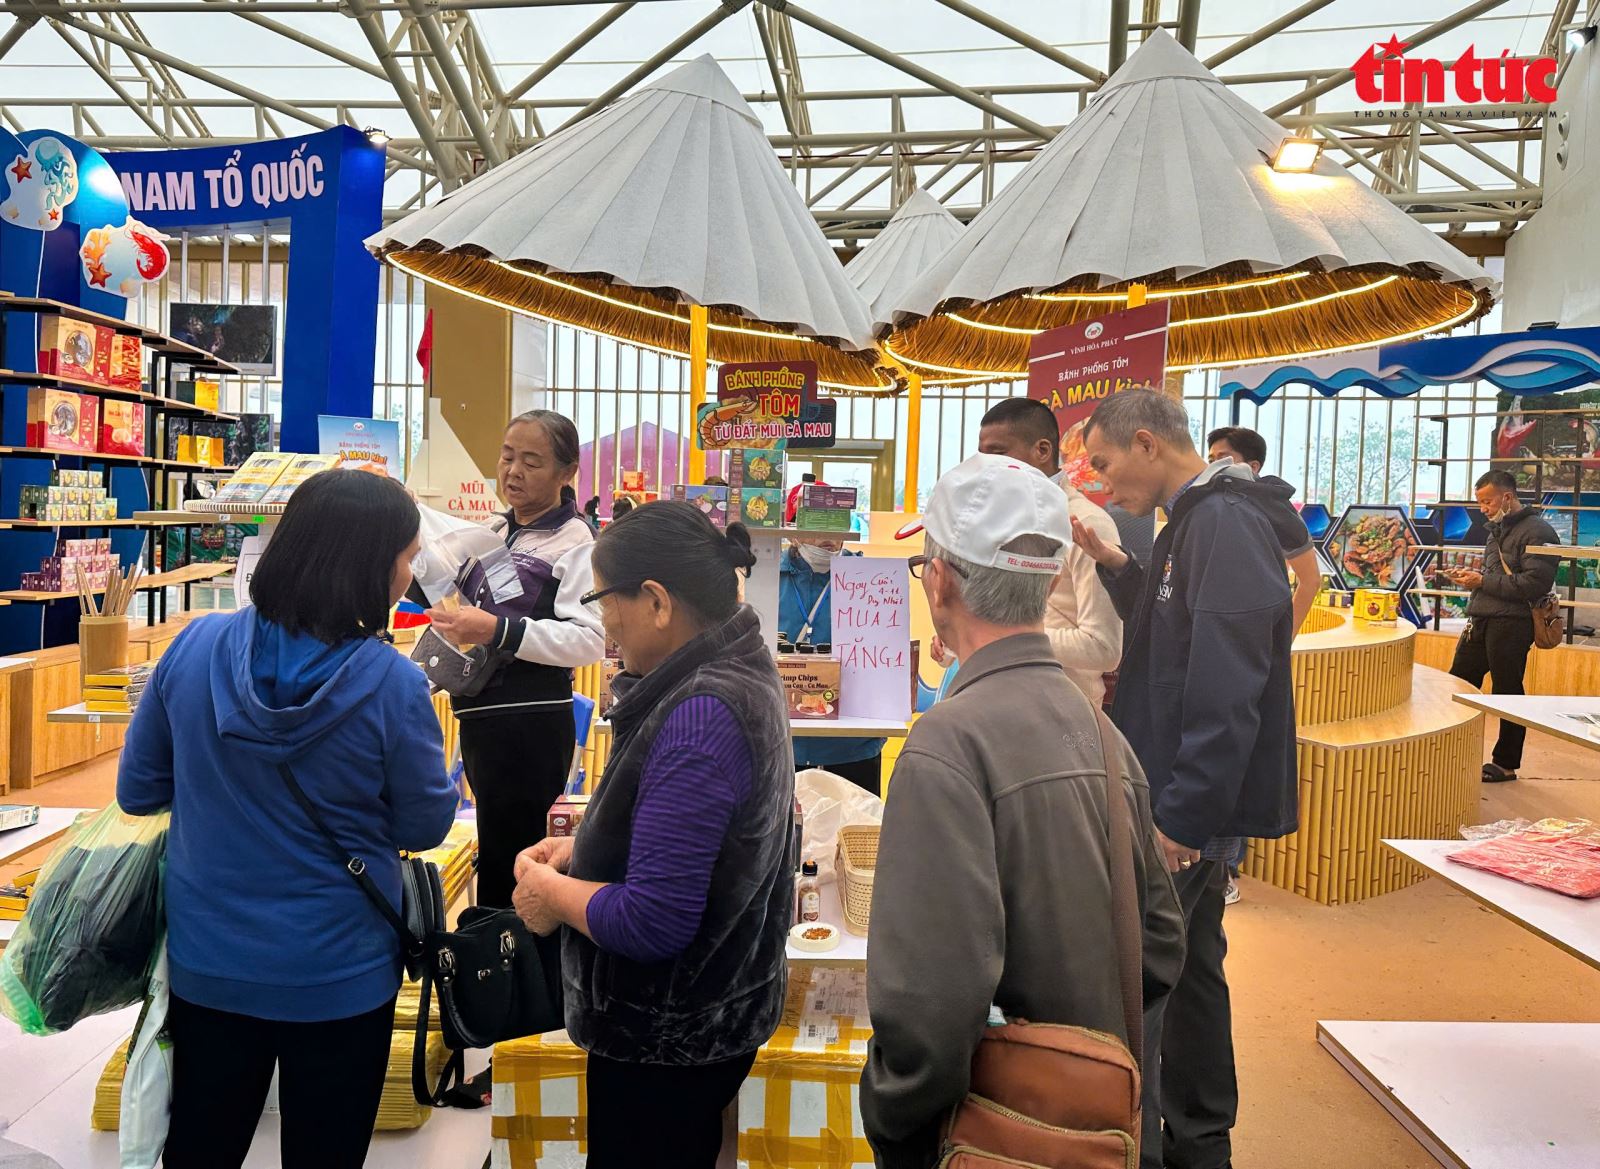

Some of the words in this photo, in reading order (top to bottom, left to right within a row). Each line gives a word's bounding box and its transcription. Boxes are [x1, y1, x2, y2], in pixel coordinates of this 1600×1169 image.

[121, 172, 196, 211] NAM
[203, 149, 244, 209] TỔ
[251, 142, 325, 209] QUỐC
[725, 369, 761, 391] BÁNH
[1058, 369, 1080, 382] BÁNH
[1112, 356, 1129, 370] TÔM
[759, 388, 801, 418] TÔM
[1067, 379, 1110, 406] MAU
[714, 421, 733, 440] TỪ
[734, 419, 757, 439] ĐẤT
[761, 422, 782, 439] MŨI
[784, 420, 802, 439] CÀ
[804, 423, 832, 438] MAU
[348, 450, 370, 461] MAU
[460, 480, 485, 495] MŨI
[448, 496, 465, 511] CÀ
[468, 499, 496, 512] MAU
[837, 607, 880, 629] MUA
[886, 609, 901, 628] 1
[836, 636, 892, 674] TẶNG
[894, 651, 905, 667] 1
[798, 674, 818, 682] Chips
